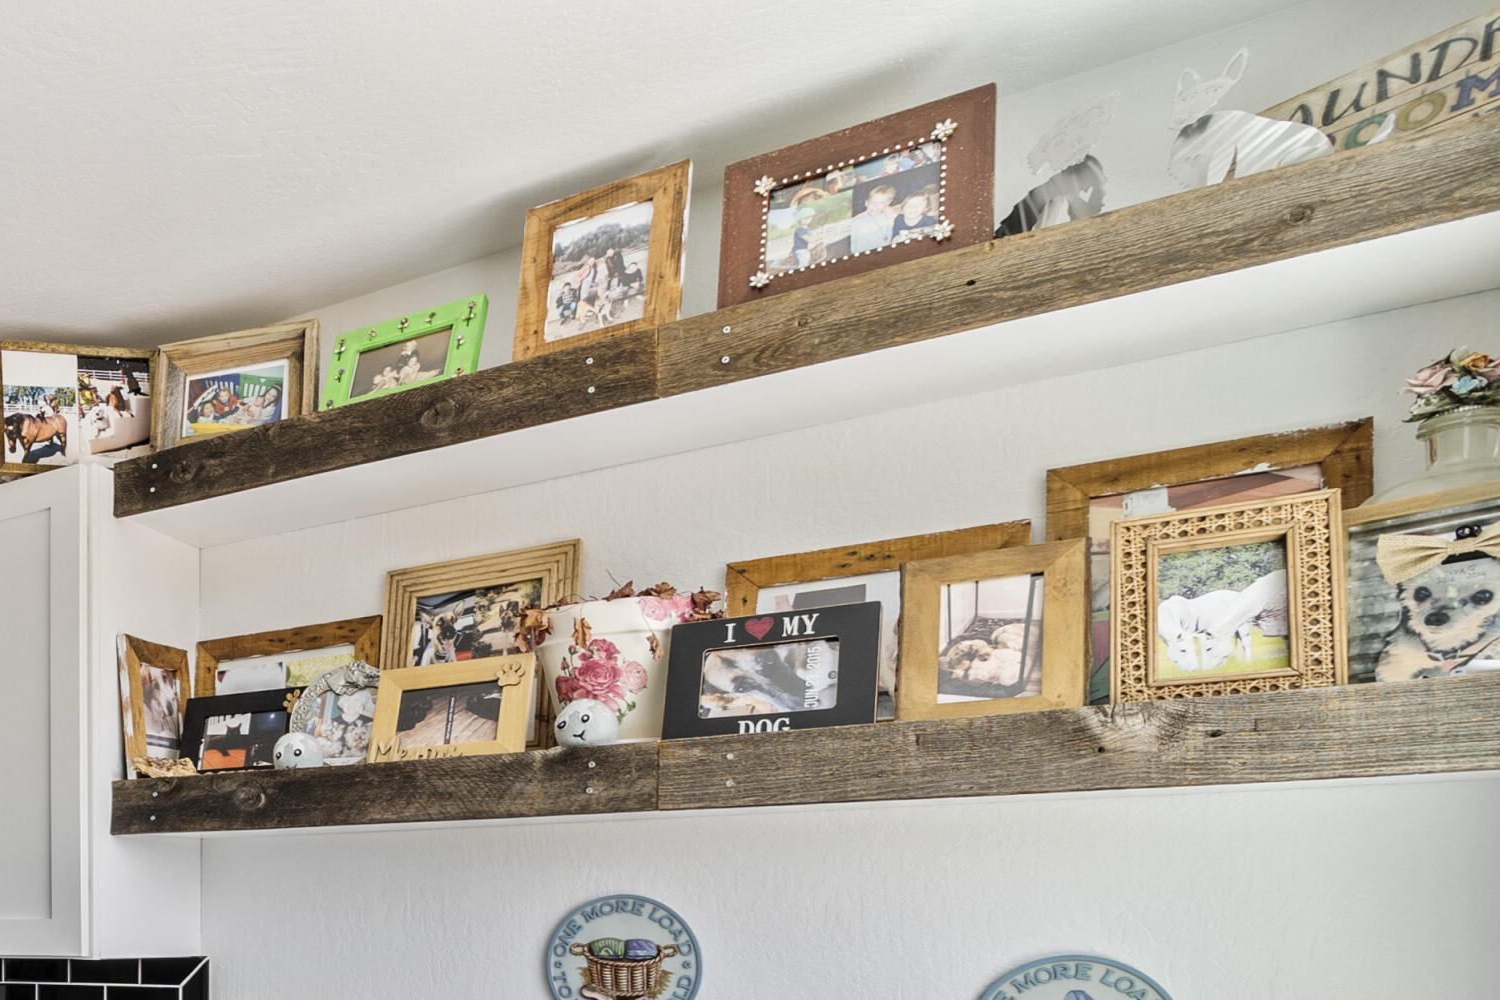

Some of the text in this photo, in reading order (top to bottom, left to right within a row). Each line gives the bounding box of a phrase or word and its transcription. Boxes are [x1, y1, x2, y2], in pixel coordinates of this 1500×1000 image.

[724, 613, 820, 643] I MY
[805, 646, 821, 669] 2015
[738, 717, 791, 735] DOG
[553, 900, 693, 958] ONE MORE LOAD
[553, 971, 573, 998] TO
[1011, 963, 1093, 994] MORE
